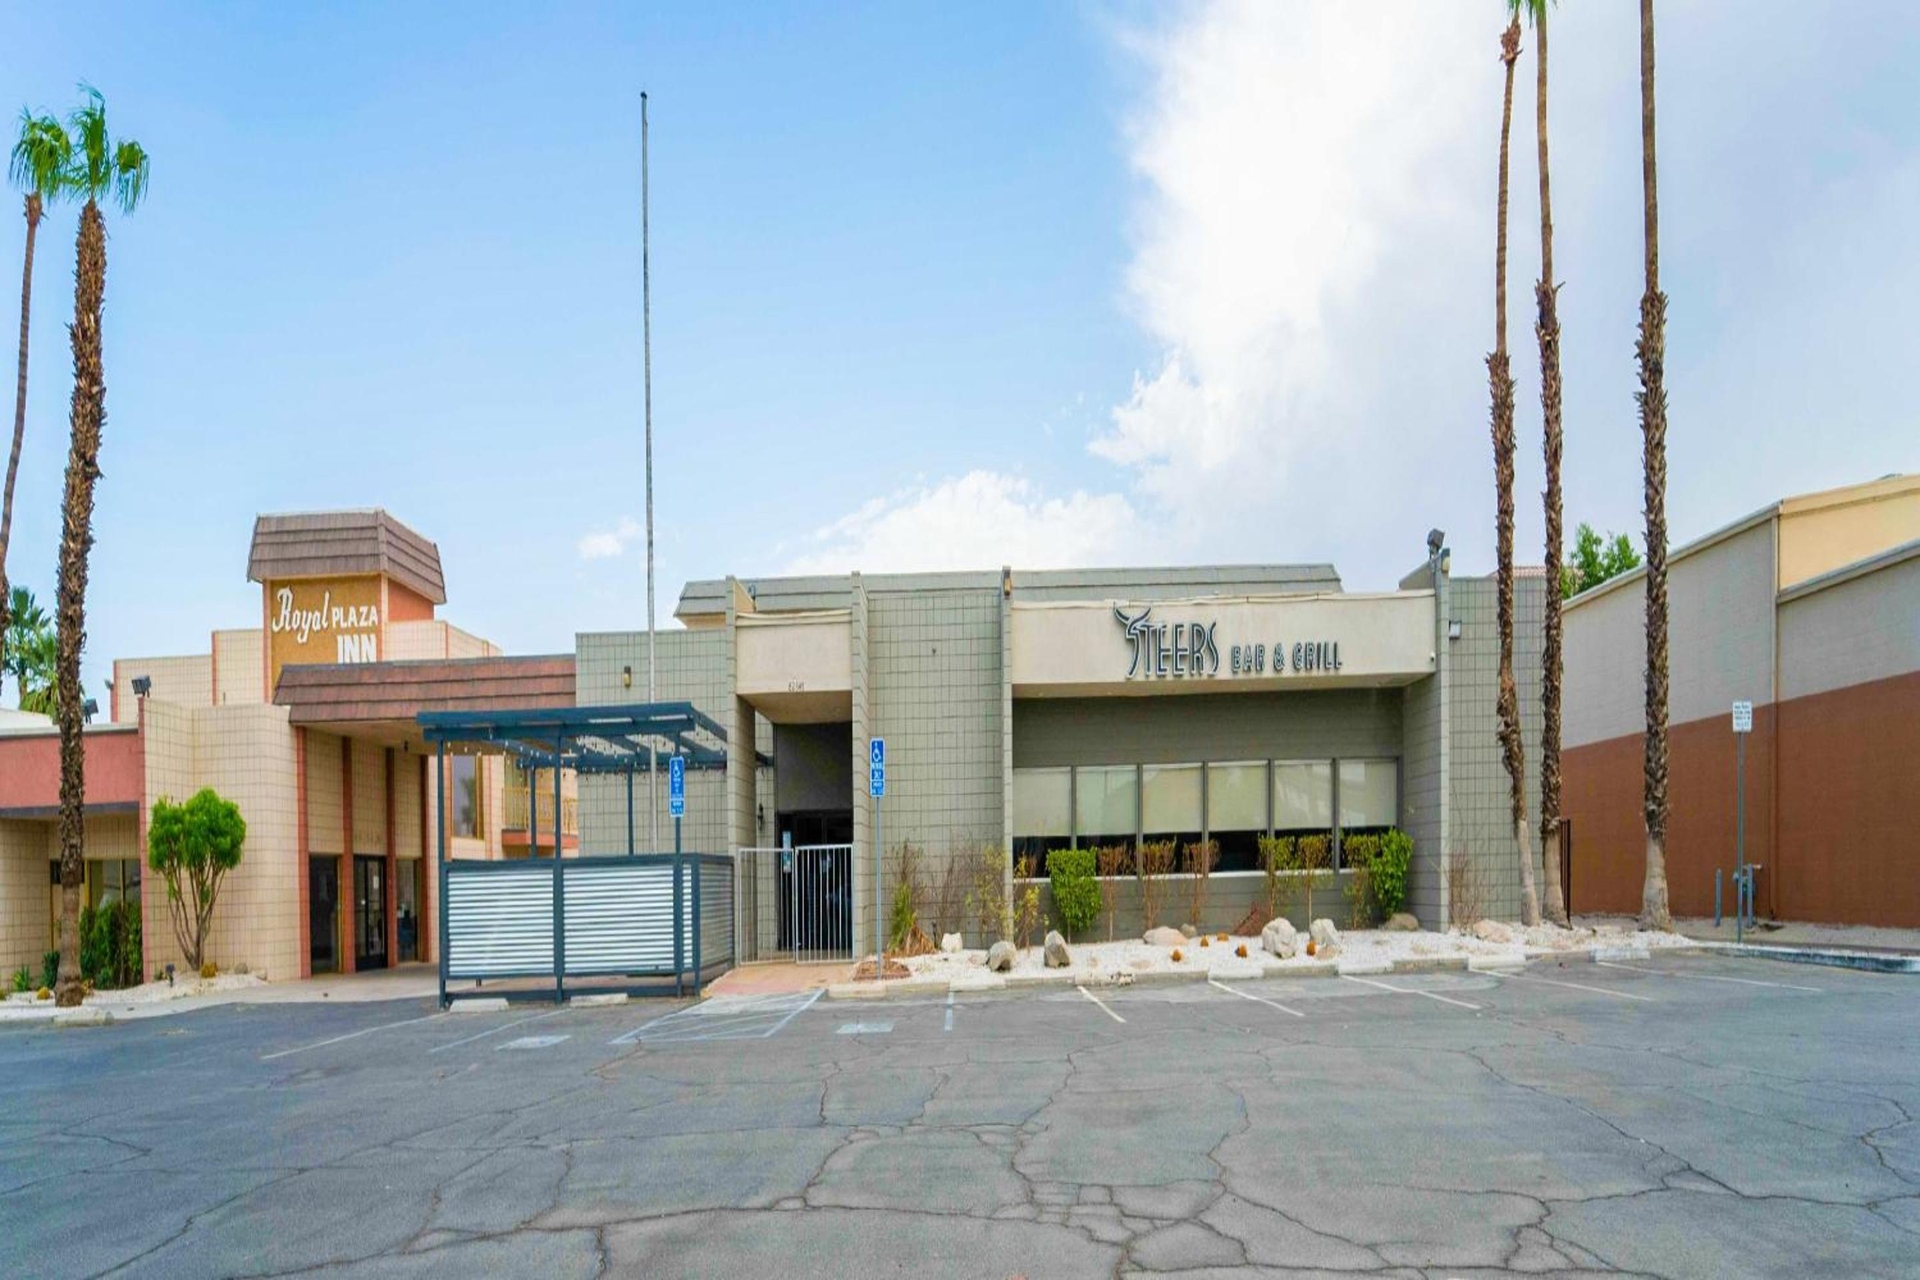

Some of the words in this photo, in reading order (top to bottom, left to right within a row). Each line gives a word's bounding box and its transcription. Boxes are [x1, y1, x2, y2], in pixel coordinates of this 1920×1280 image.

[272, 586, 330, 643] Royal
[331, 606, 378, 628] PLAZA
[1122, 608, 1220, 678] STEERS
[1232, 644, 1265, 673] BAR
[1274, 643, 1285, 671] &
[1293, 641, 1343, 672] GRILL
[337, 634, 377, 664] INN
